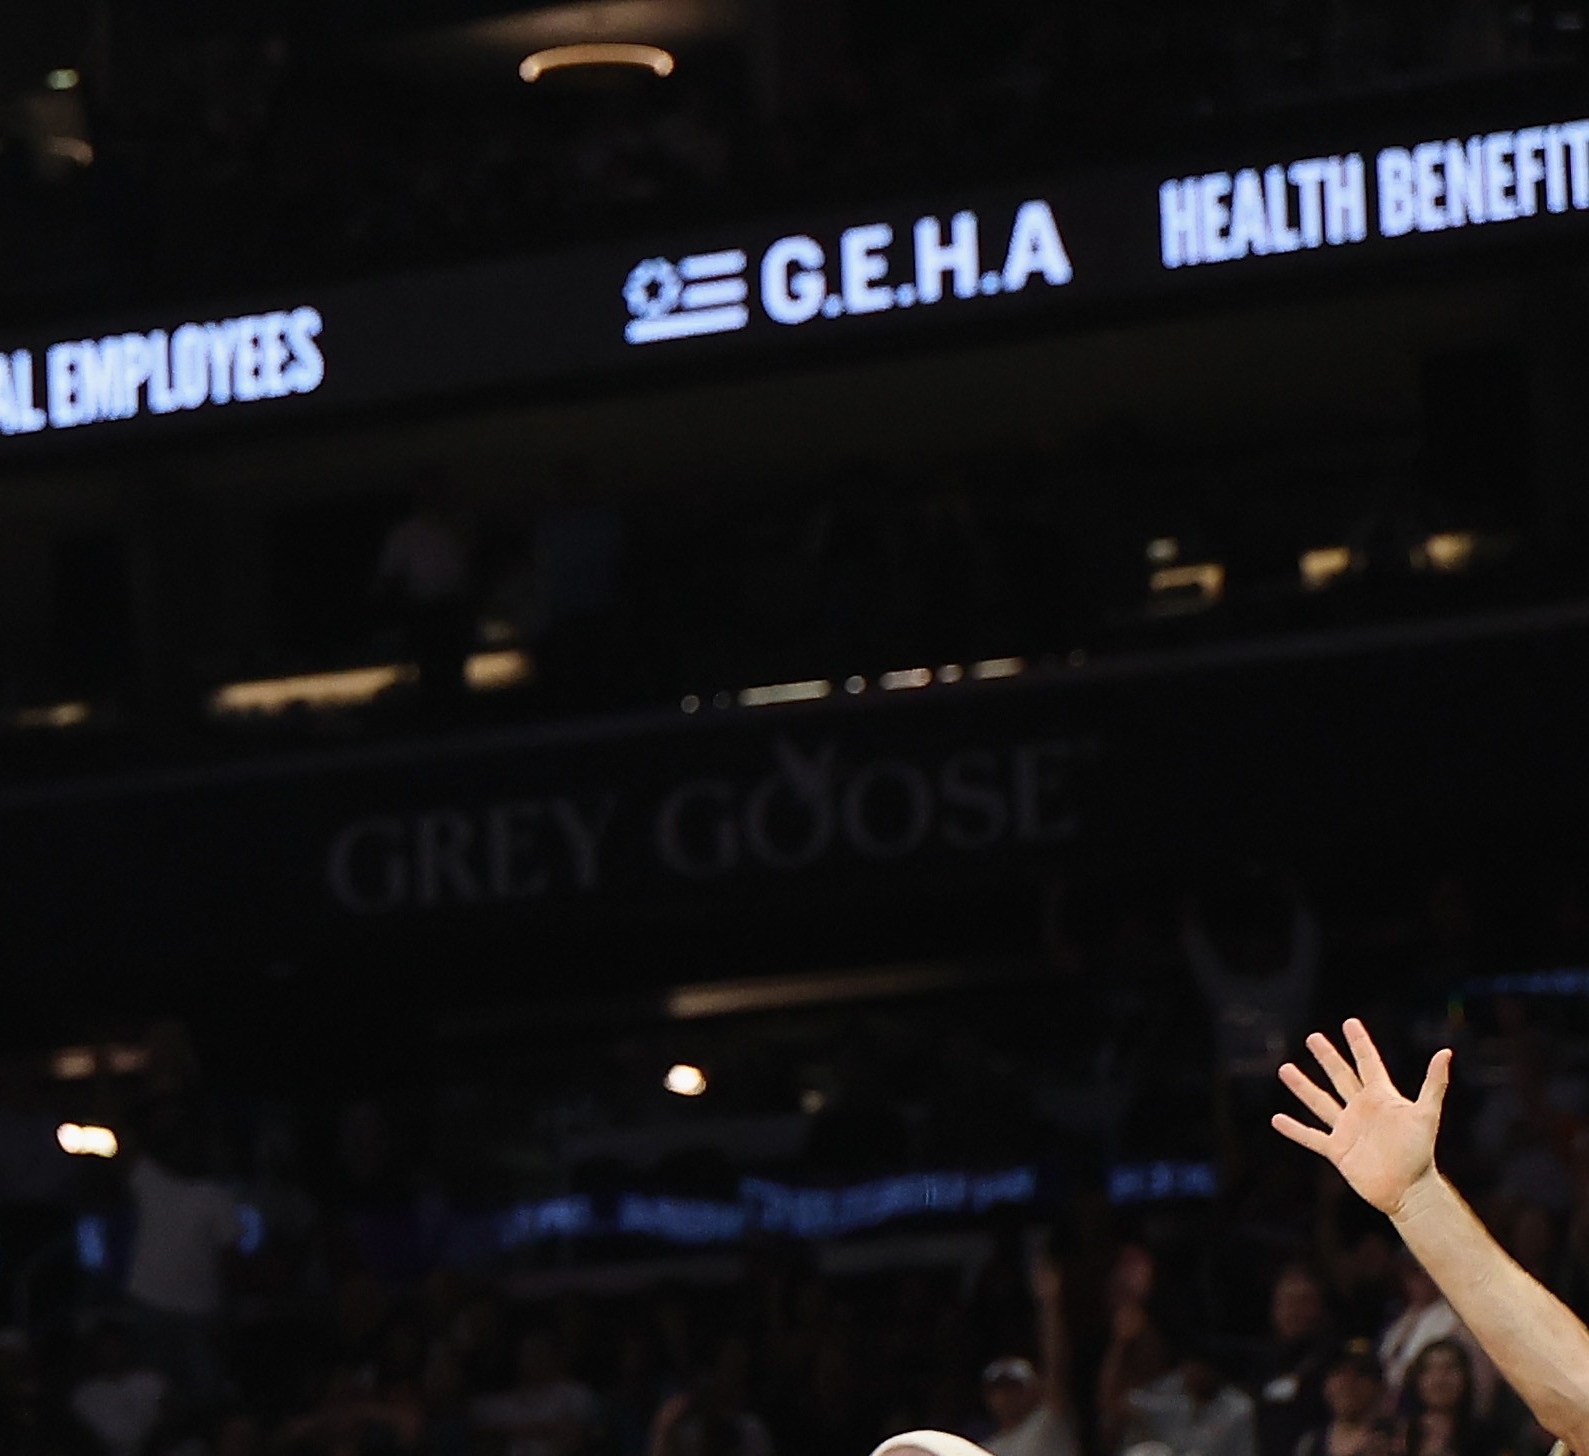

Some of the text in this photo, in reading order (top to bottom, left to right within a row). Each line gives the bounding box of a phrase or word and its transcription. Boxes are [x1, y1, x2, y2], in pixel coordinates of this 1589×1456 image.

[760, 199, 1073, 326] G.E.H.A
[1159, 152, 1367, 270] HEALTH
[47, 305, 324, 429] EMPLOYEES
[325, 737, 1087, 916] GREY GOOSE
